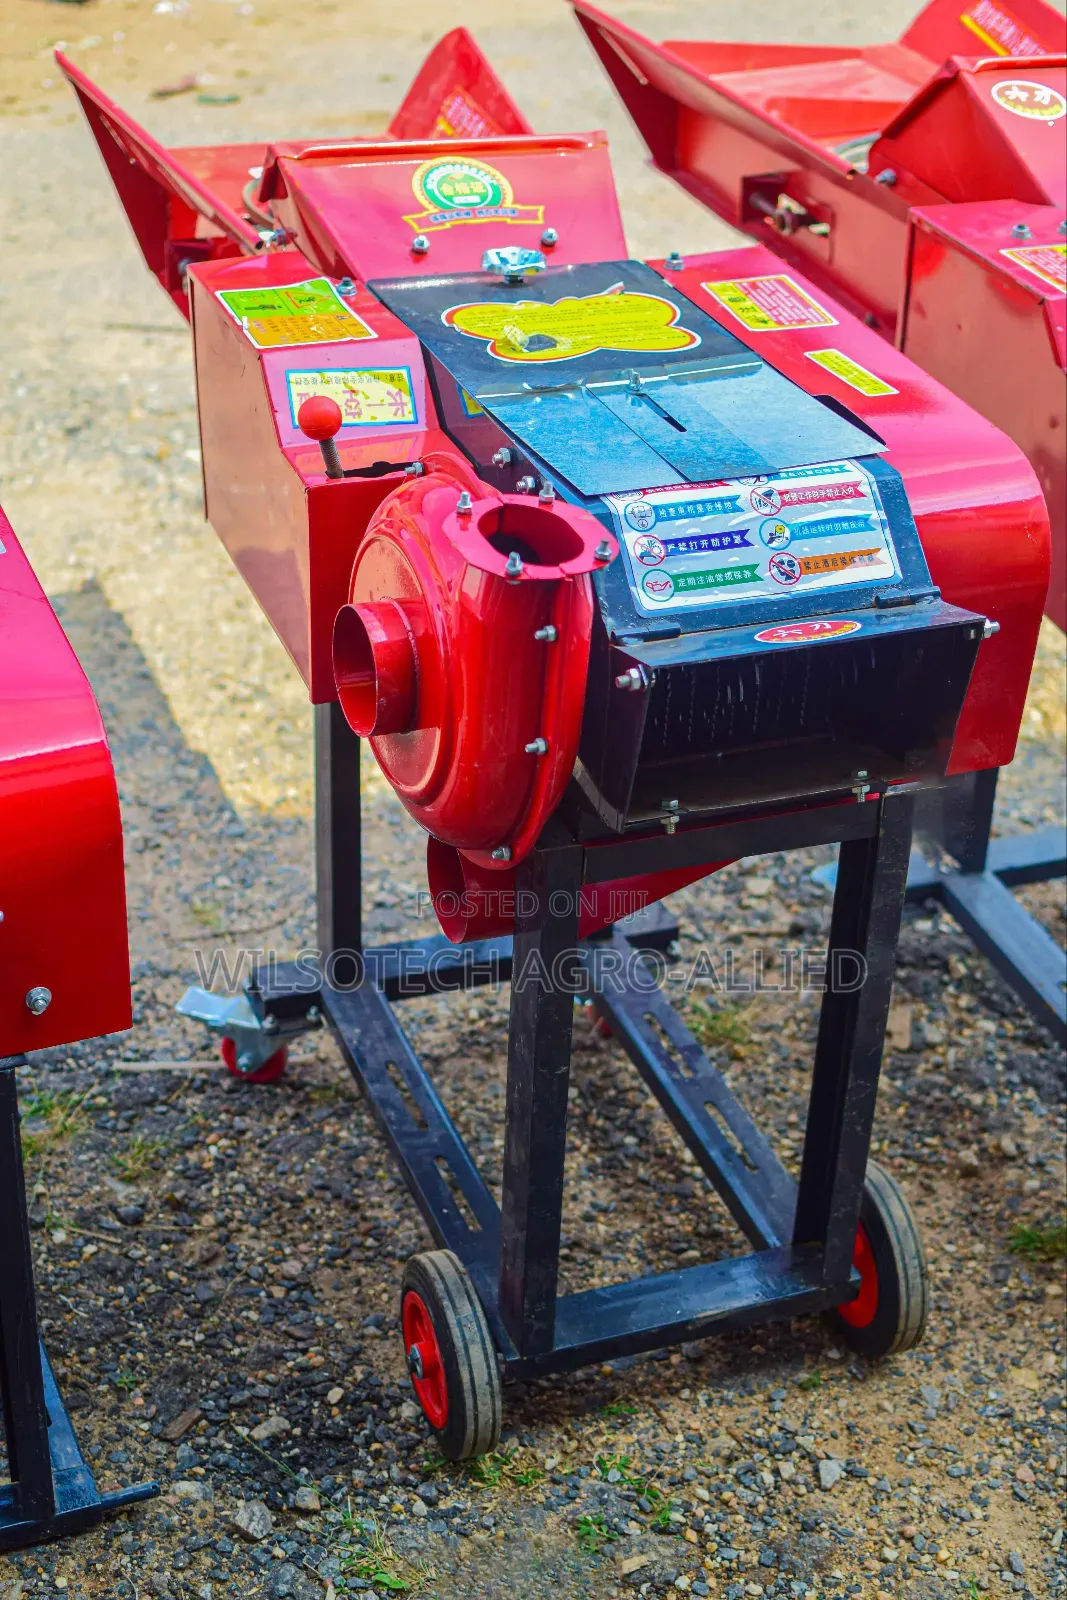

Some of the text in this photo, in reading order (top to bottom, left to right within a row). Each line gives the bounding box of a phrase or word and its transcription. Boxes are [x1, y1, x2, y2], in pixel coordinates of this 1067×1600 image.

[658, 500, 734, 517] 检查电机是否接地
[666, 535, 744, 552] 严禁打开防护罩
[676, 569, 752, 587] 定期注油常规保养
